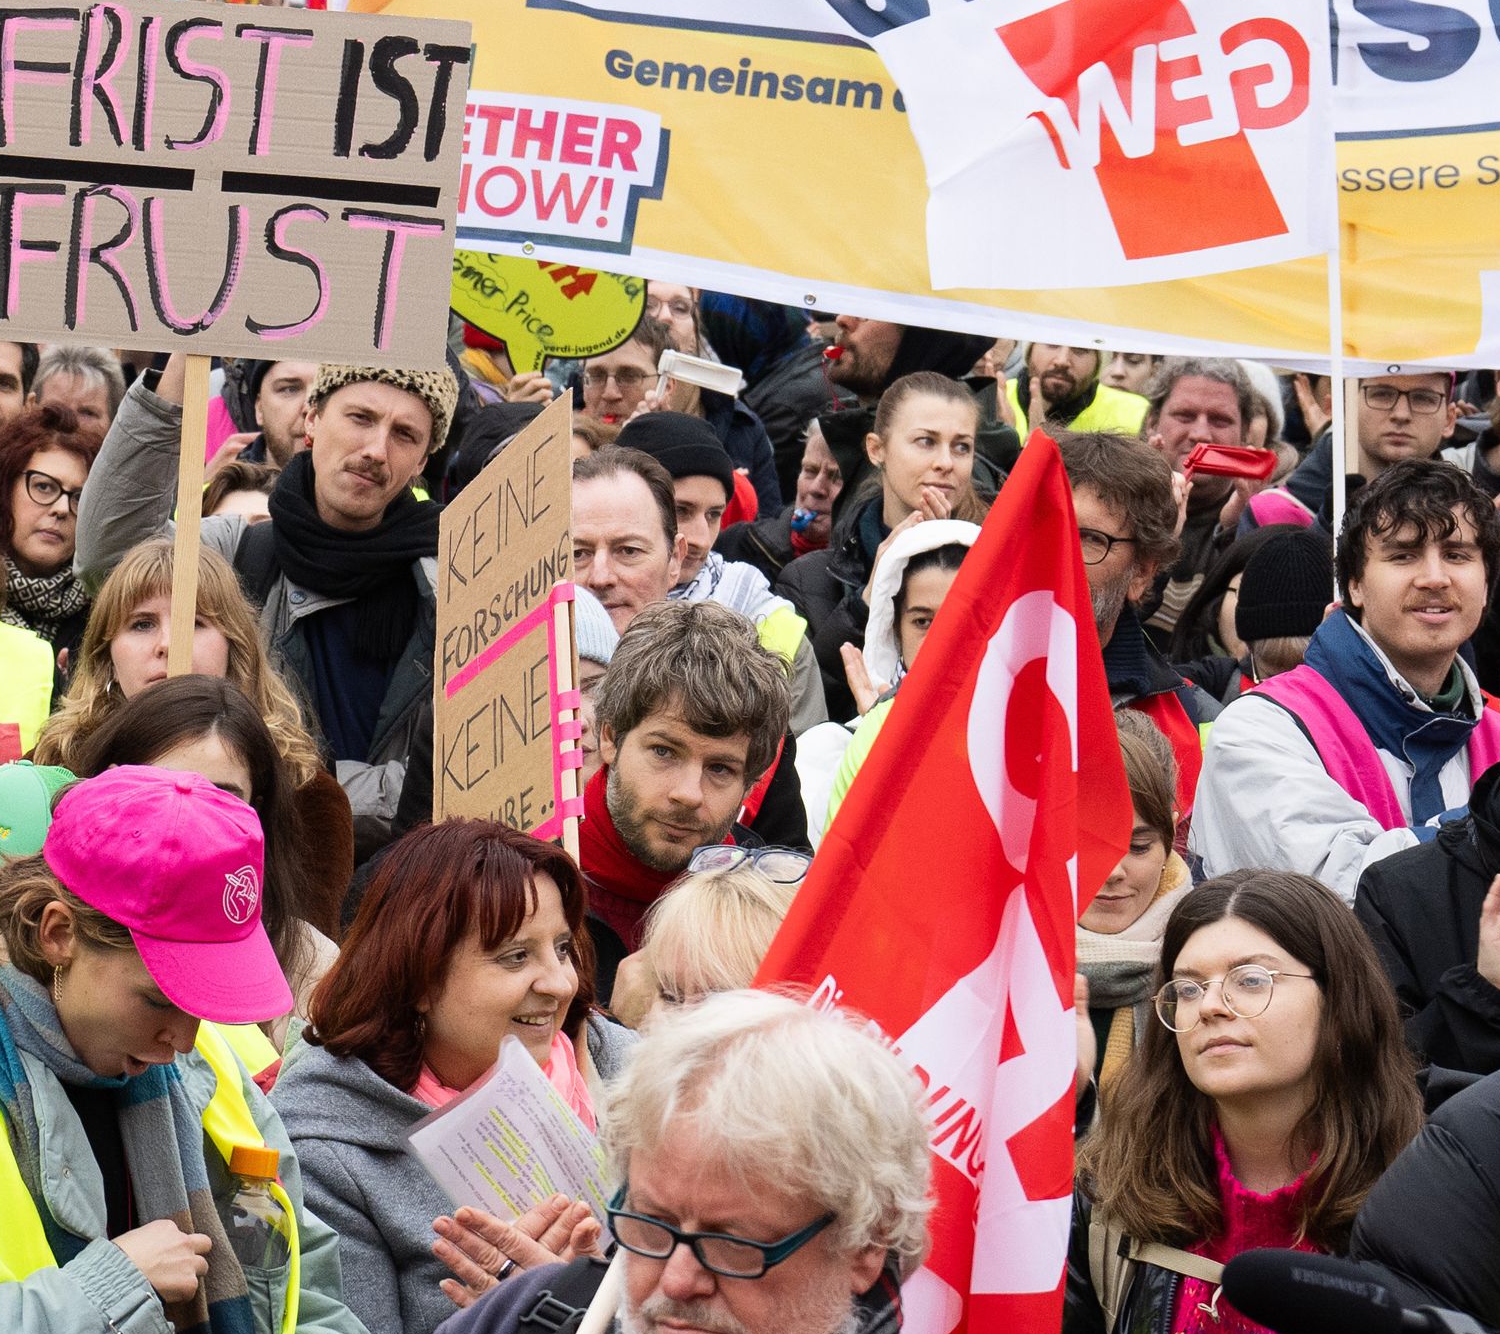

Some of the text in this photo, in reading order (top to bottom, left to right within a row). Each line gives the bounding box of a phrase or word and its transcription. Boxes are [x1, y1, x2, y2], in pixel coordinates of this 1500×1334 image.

[332, 35, 472, 163] IST
[605, 48, 884, 110] Gemeinsam
[505, 290, 555, 338] Price
[445, 435, 559, 604] KEINE
[441, 529, 571, 690] FORSCHUNG
[441, 654, 553, 819] KEINE
